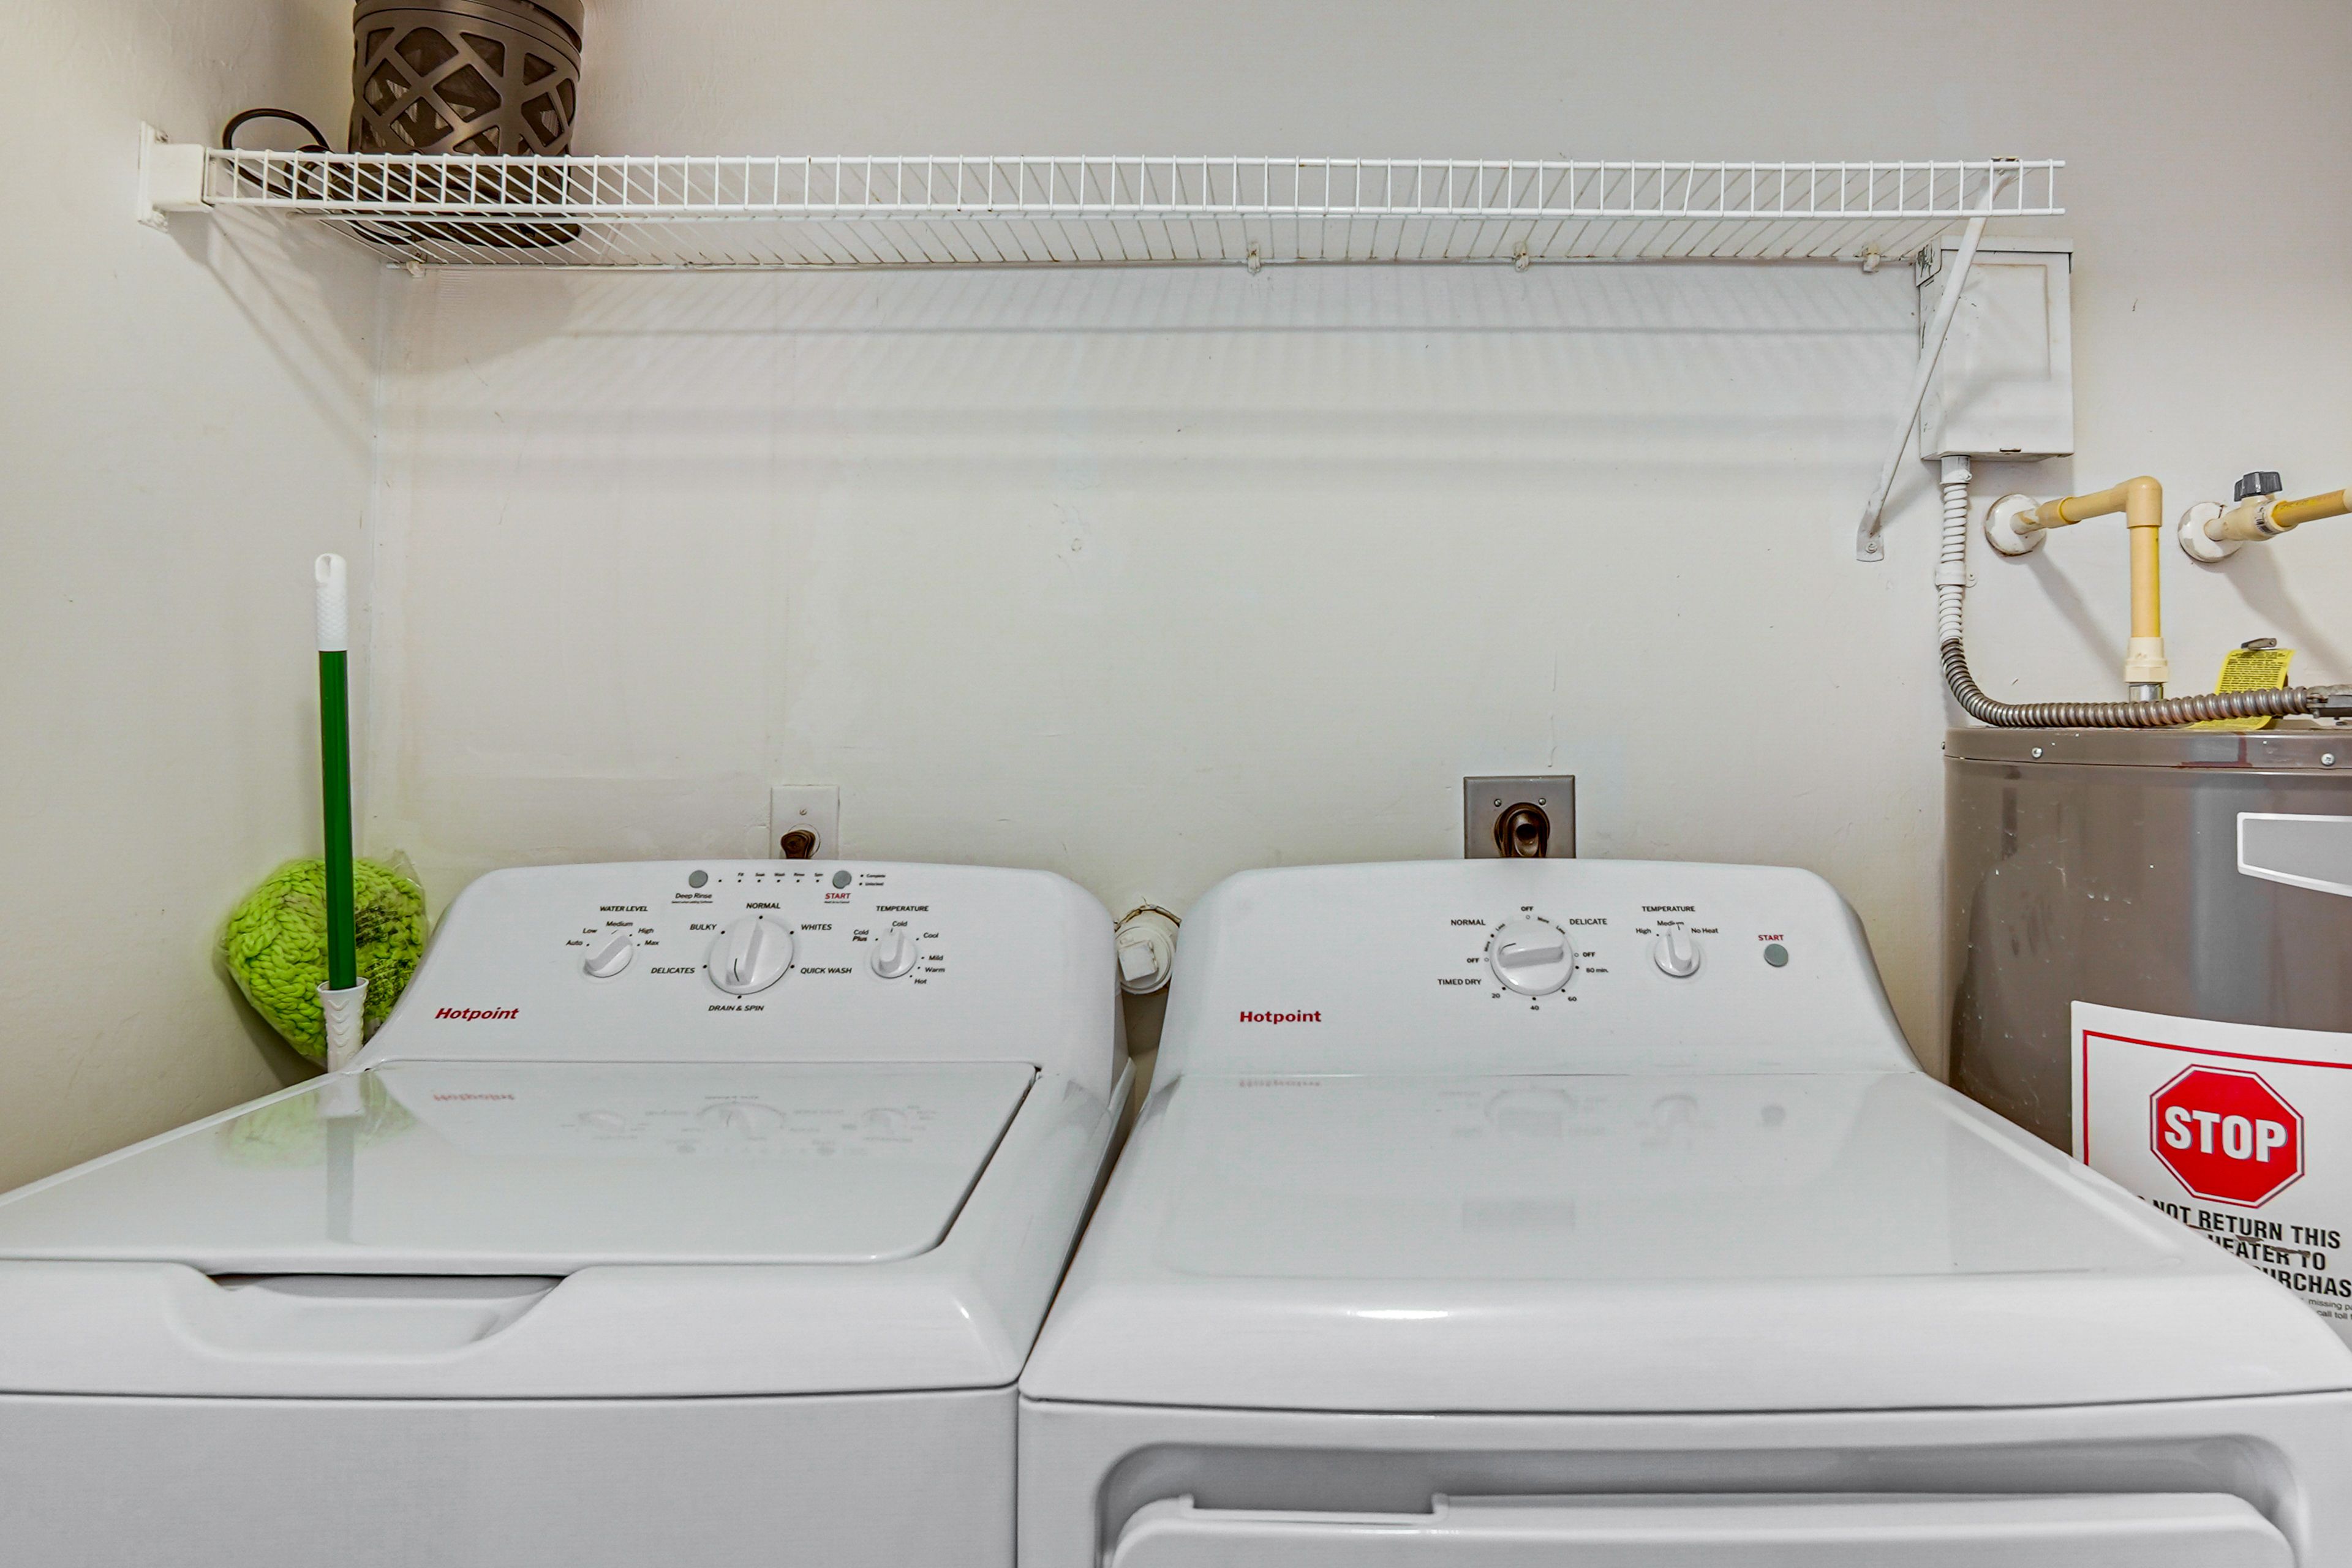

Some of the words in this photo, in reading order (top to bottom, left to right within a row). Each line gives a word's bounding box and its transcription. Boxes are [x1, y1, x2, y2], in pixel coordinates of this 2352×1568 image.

[435, 1007, 519, 1021] Hotpoint
[1240, 1010, 1321, 1024] Hotpoint
[2165, 1106, 2288, 1163] STOP
[2198, 1210, 2282, 1241] RETURN
[2291, 1226, 2341, 1249] THIS
[2309, 1298, 2342, 1310] missing
